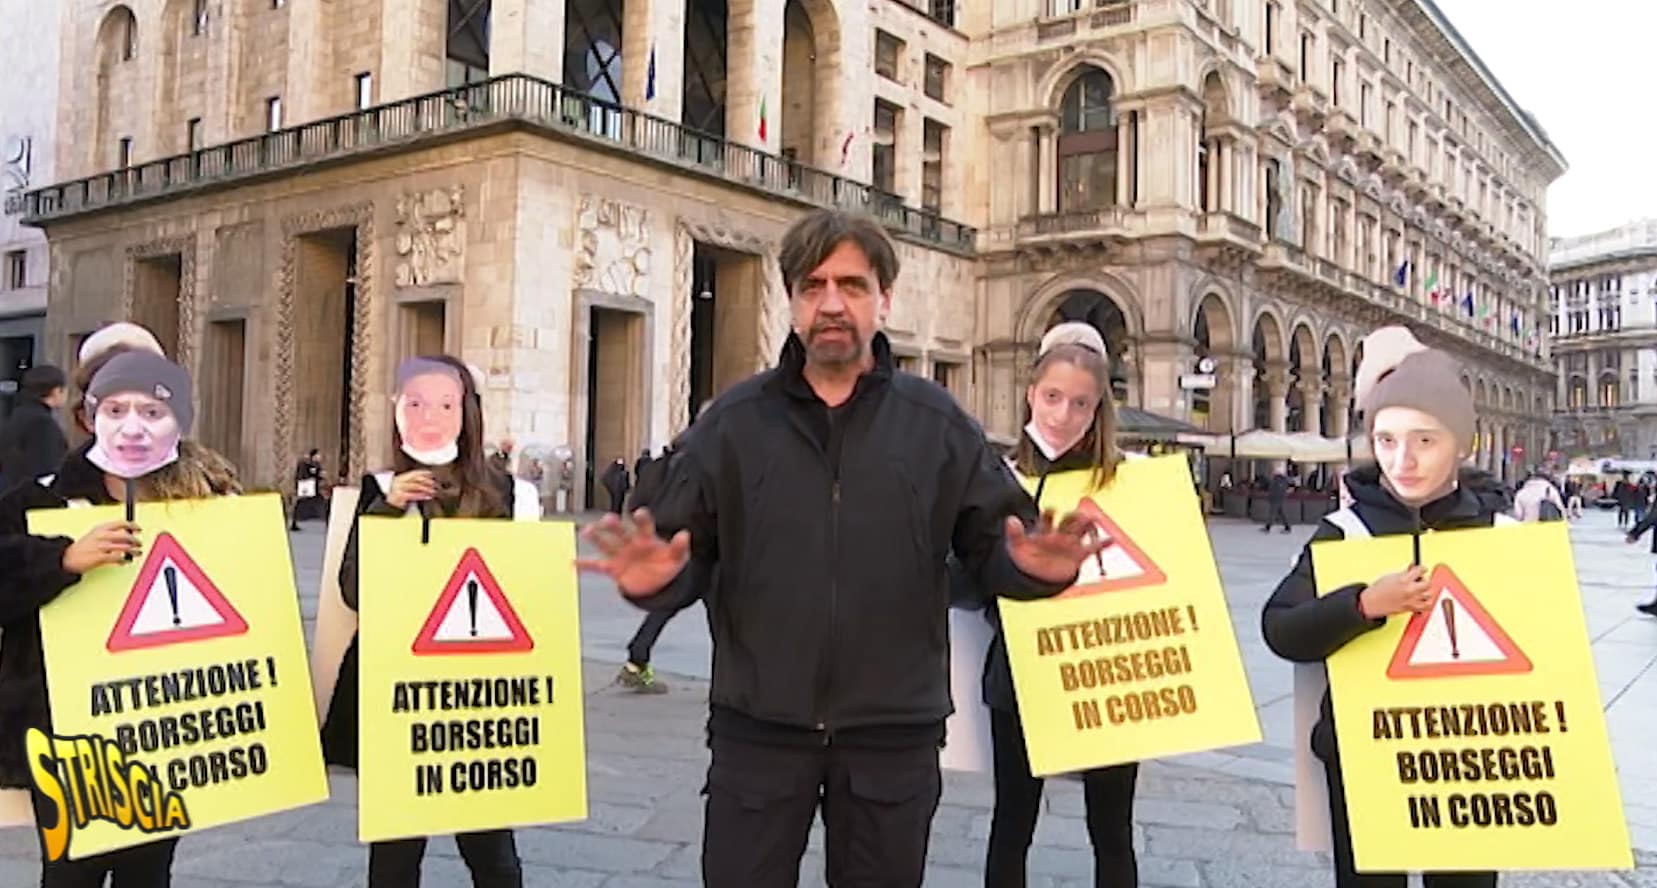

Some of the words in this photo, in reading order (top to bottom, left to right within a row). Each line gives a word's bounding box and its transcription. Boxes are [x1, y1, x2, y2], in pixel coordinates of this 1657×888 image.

[1037, 608, 1185, 656] ATTENZIONE
[1060, 646, 1191, 692] BORSEGGI
[91, 664, 261, 717] ATTENZIONE
[393, 677, 540, 713] ATTENZIONE
[1073, 700, 1102, 730] IN
[1105, 685, 1197, 725] CORSO
[116, 702, 266, 755] BORSEGGI
[411, 717, 539, 752] BORSEGGI
[1373, 702, 1550, 739] ATTENZIONE
[167, 744, 266, 792] CORSO
[416, 765, 442, 796] IN
[451, 757, 536, 792] CORSO
[1396, 746, 1555, 784] BORSEGGI
[1408, 794, 1441, 828] IN
[1448, 791, 1558, 827] CORSO
